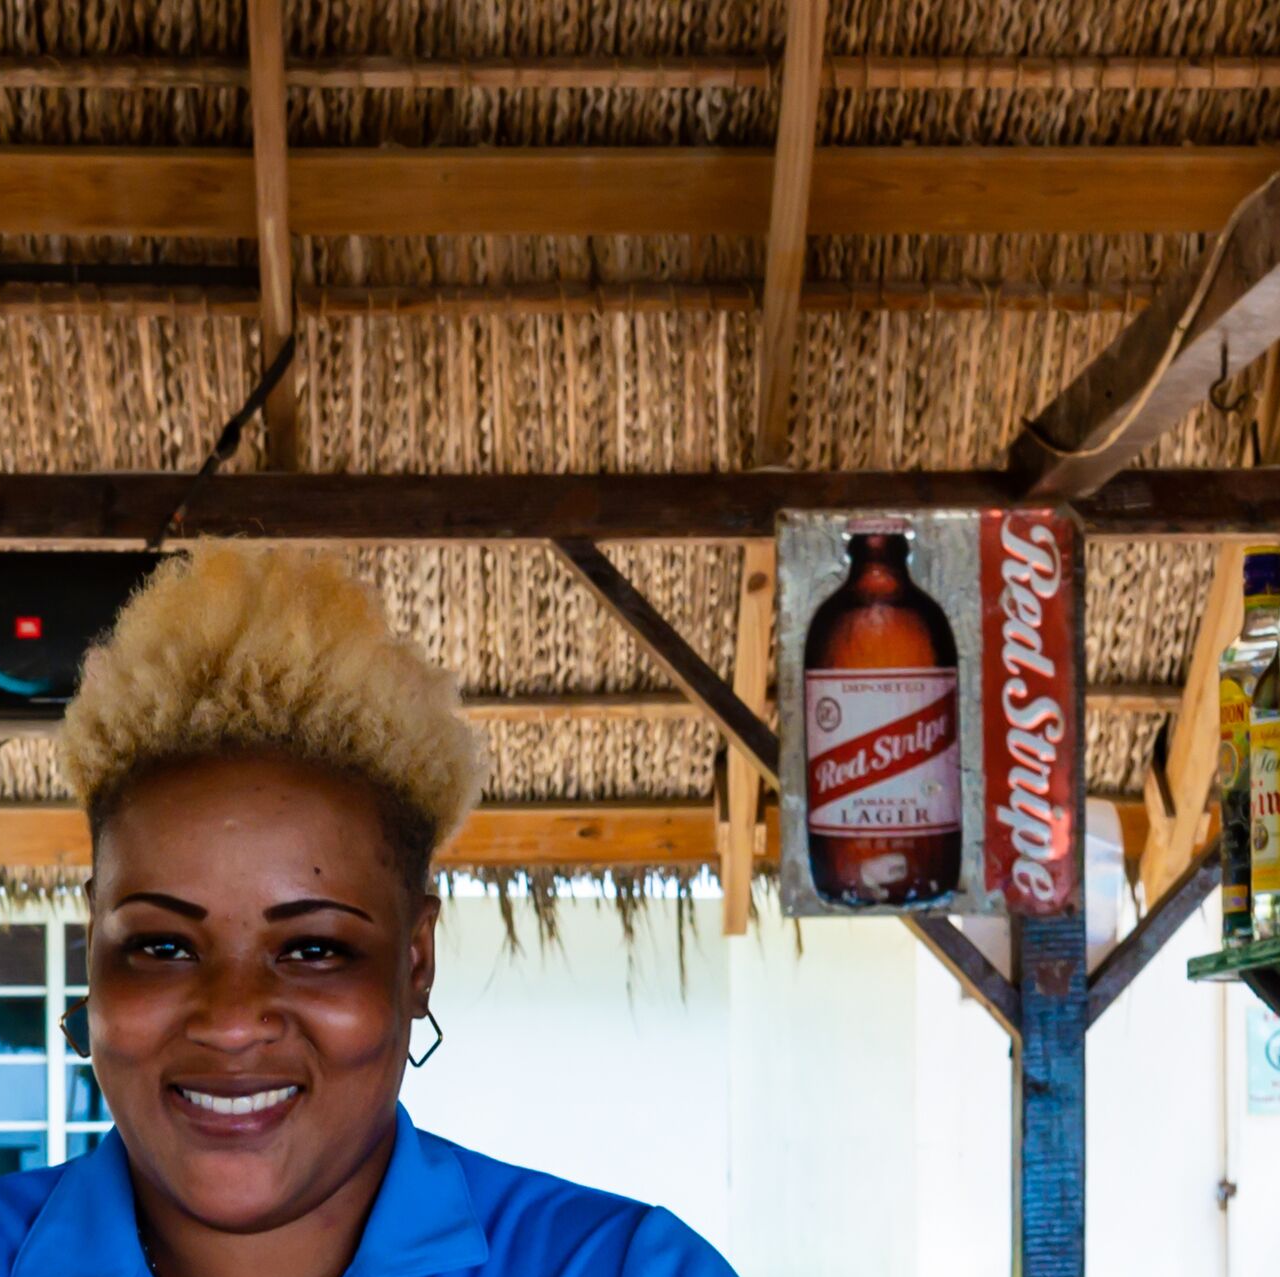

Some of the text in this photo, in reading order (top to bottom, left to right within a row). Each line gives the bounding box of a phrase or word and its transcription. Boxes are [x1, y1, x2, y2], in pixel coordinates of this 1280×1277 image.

[997, 516, 1064, 901] Red Stripe
[815, 749, 869, 795] Red
[841, 808, 930, 824] LAGER
